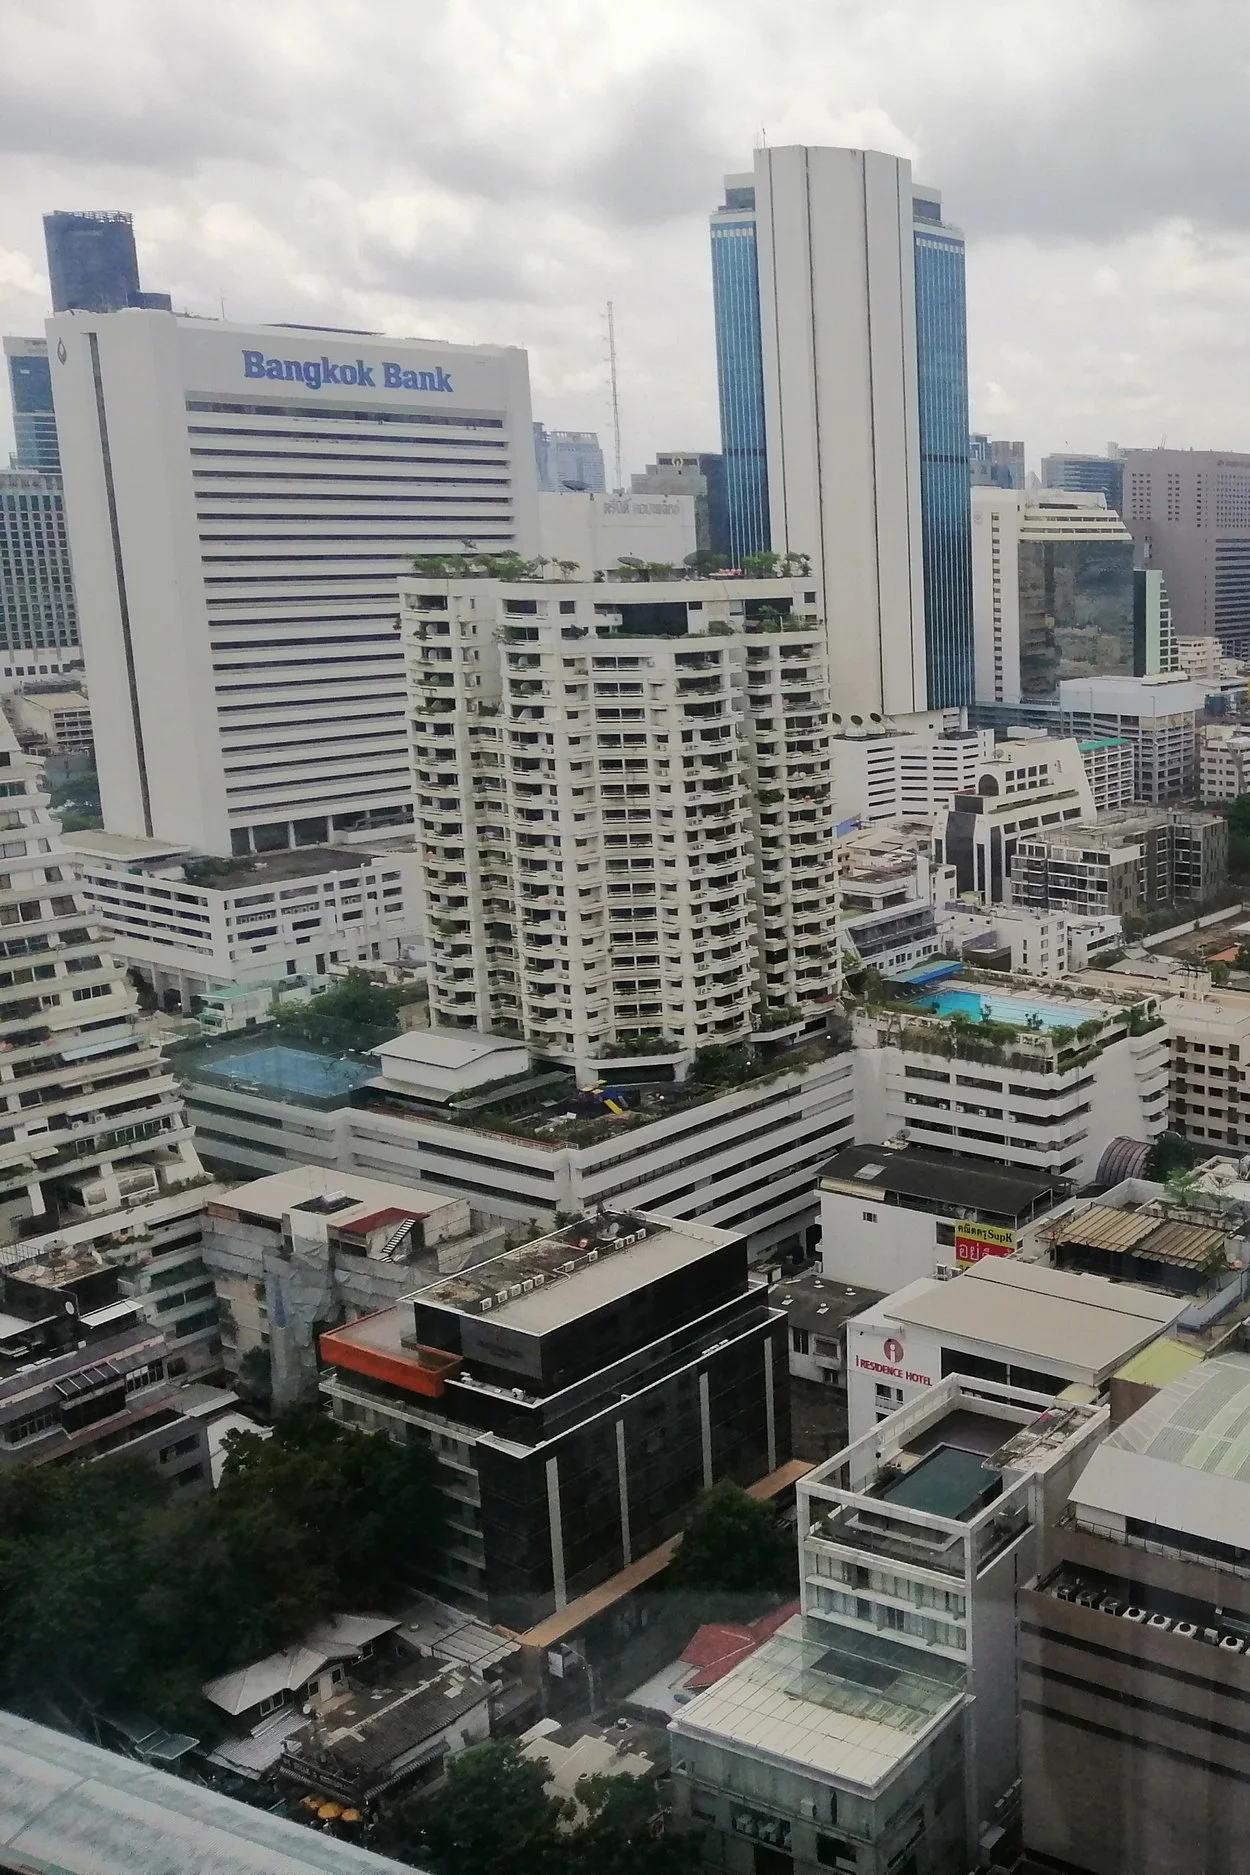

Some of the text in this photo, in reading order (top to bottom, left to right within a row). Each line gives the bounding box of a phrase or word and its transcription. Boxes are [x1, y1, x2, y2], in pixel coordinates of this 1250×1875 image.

[242, 350, 454, 392] Bangkok Bank
[860, 1359, 904, 1378] RESIDENCE
[905, 1371, 933, 1387] HOTEL
